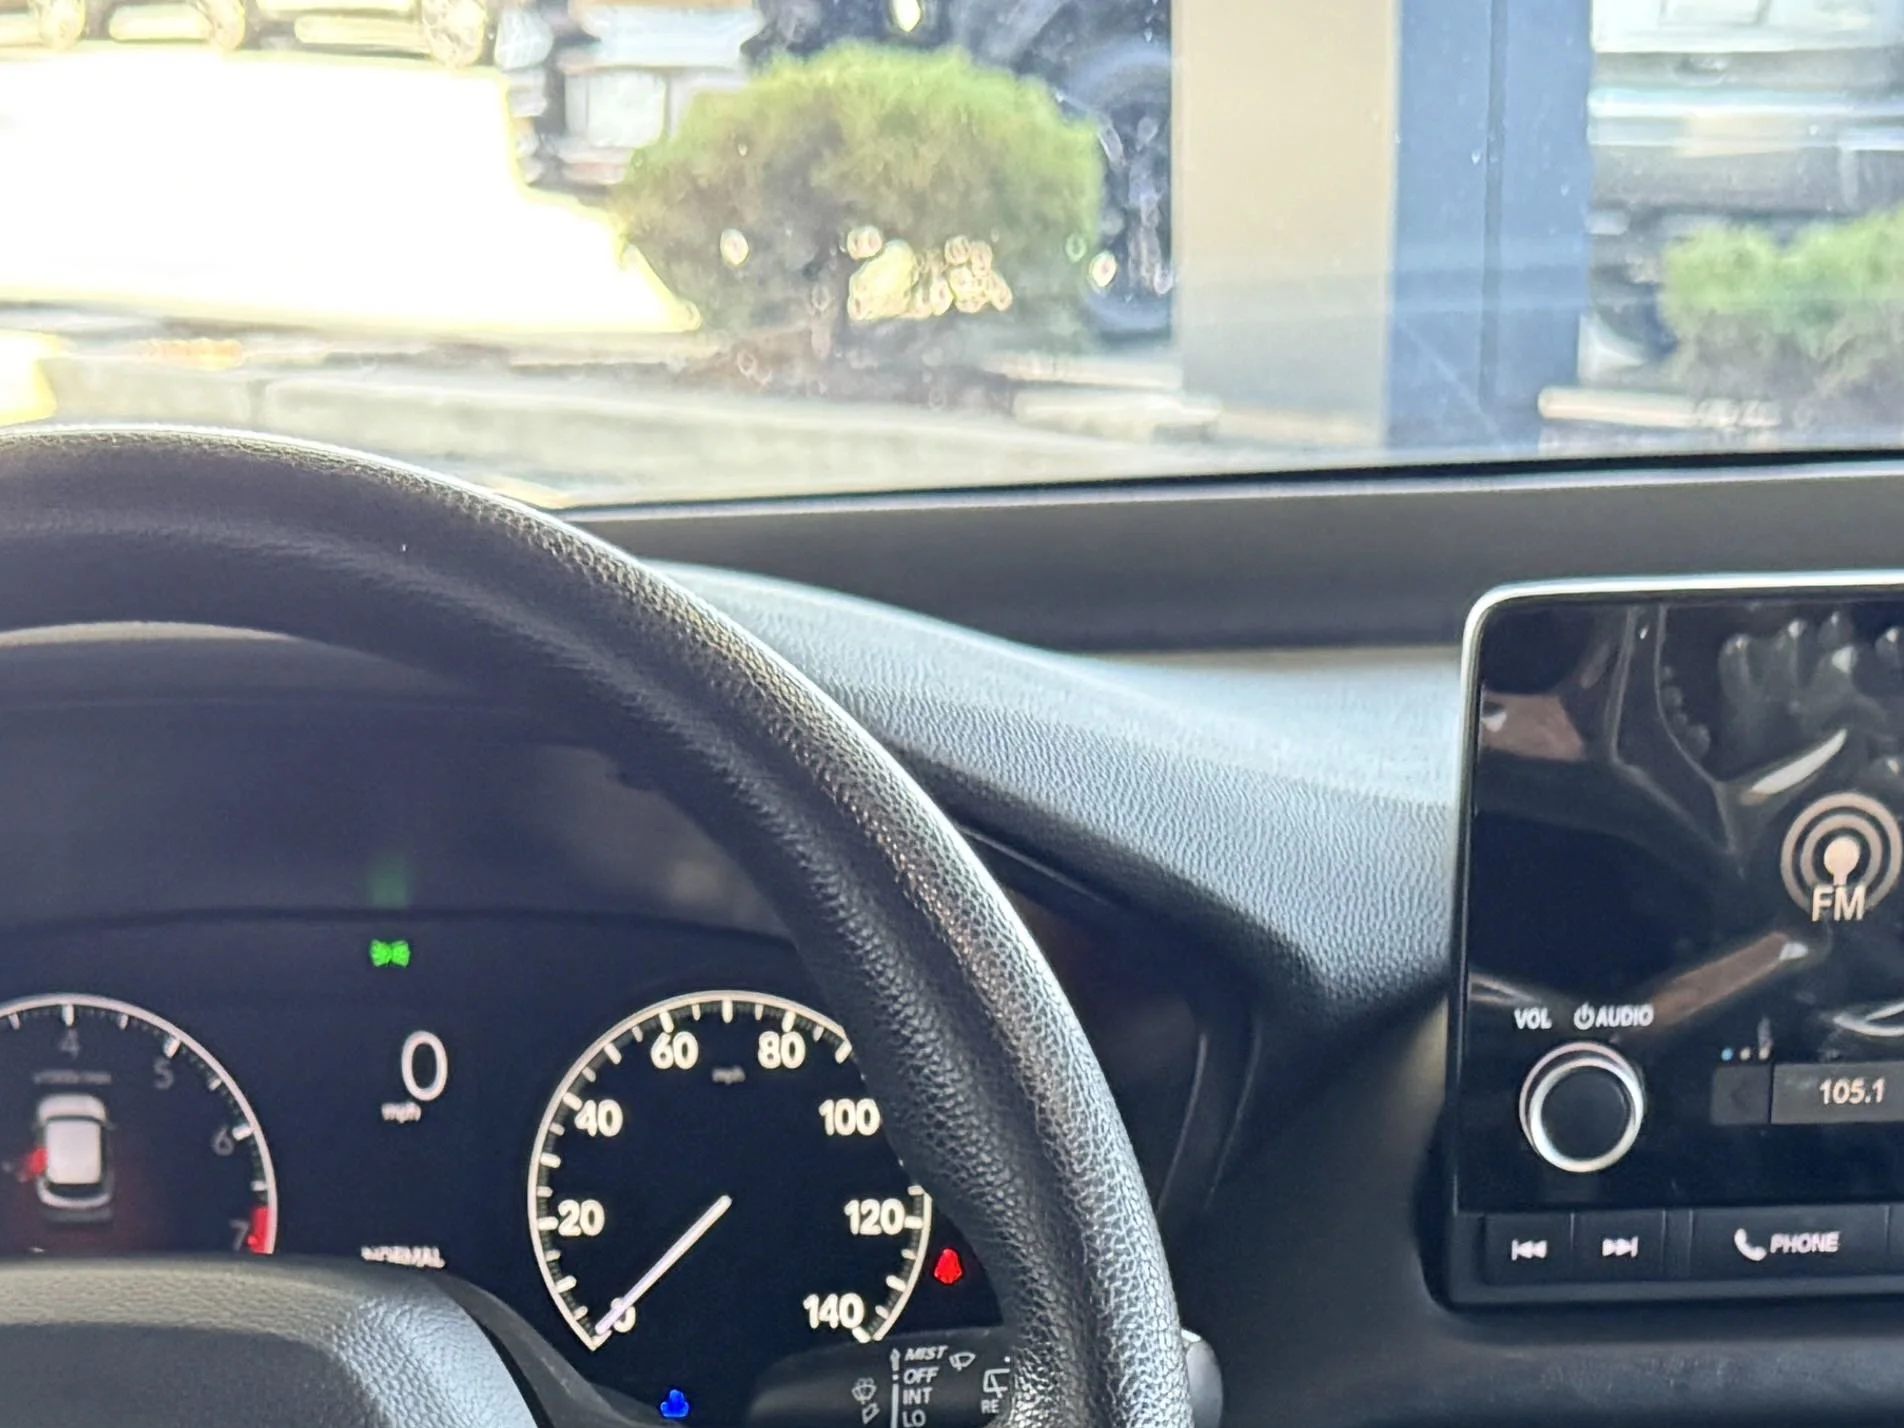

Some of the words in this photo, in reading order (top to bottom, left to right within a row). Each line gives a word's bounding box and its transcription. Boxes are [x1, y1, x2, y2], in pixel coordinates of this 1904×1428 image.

[1811, 885, 1865, 922] FM
[1514, 1007, 1552, 1030] VOL
[1595, 1003, 1654, 1027] AUDIO
[58, 1029, 80, 1058] 4
[650, 1031, 698, 1069] 60
[757, 1031, 806, 1069] 80
[153, 1058, 175, 1091] 5
[401, 1030, 448, 1101] 0
[1819, 1077, 1885, 1105] 105.1
[575, 1099, 623, 1136] 40
[819, 1098, 881, 1136] 100
[210, 1129, 235, 1156] 6
[557, 1198, 605, 1236] 20
[844, 1198, 905, 1235] 120
[229, 1219, 250, 1252] 7
[1770, 1231, 1840, 1254] PHONE
[803, 1293, 865, 1329] 140
[904, 1345, 948, 1361] MIST
[903, 1367, 939, 1384] OFF
[903, 1387, 933, 1404] INT
[903, 1409, 926, 1428] LO
